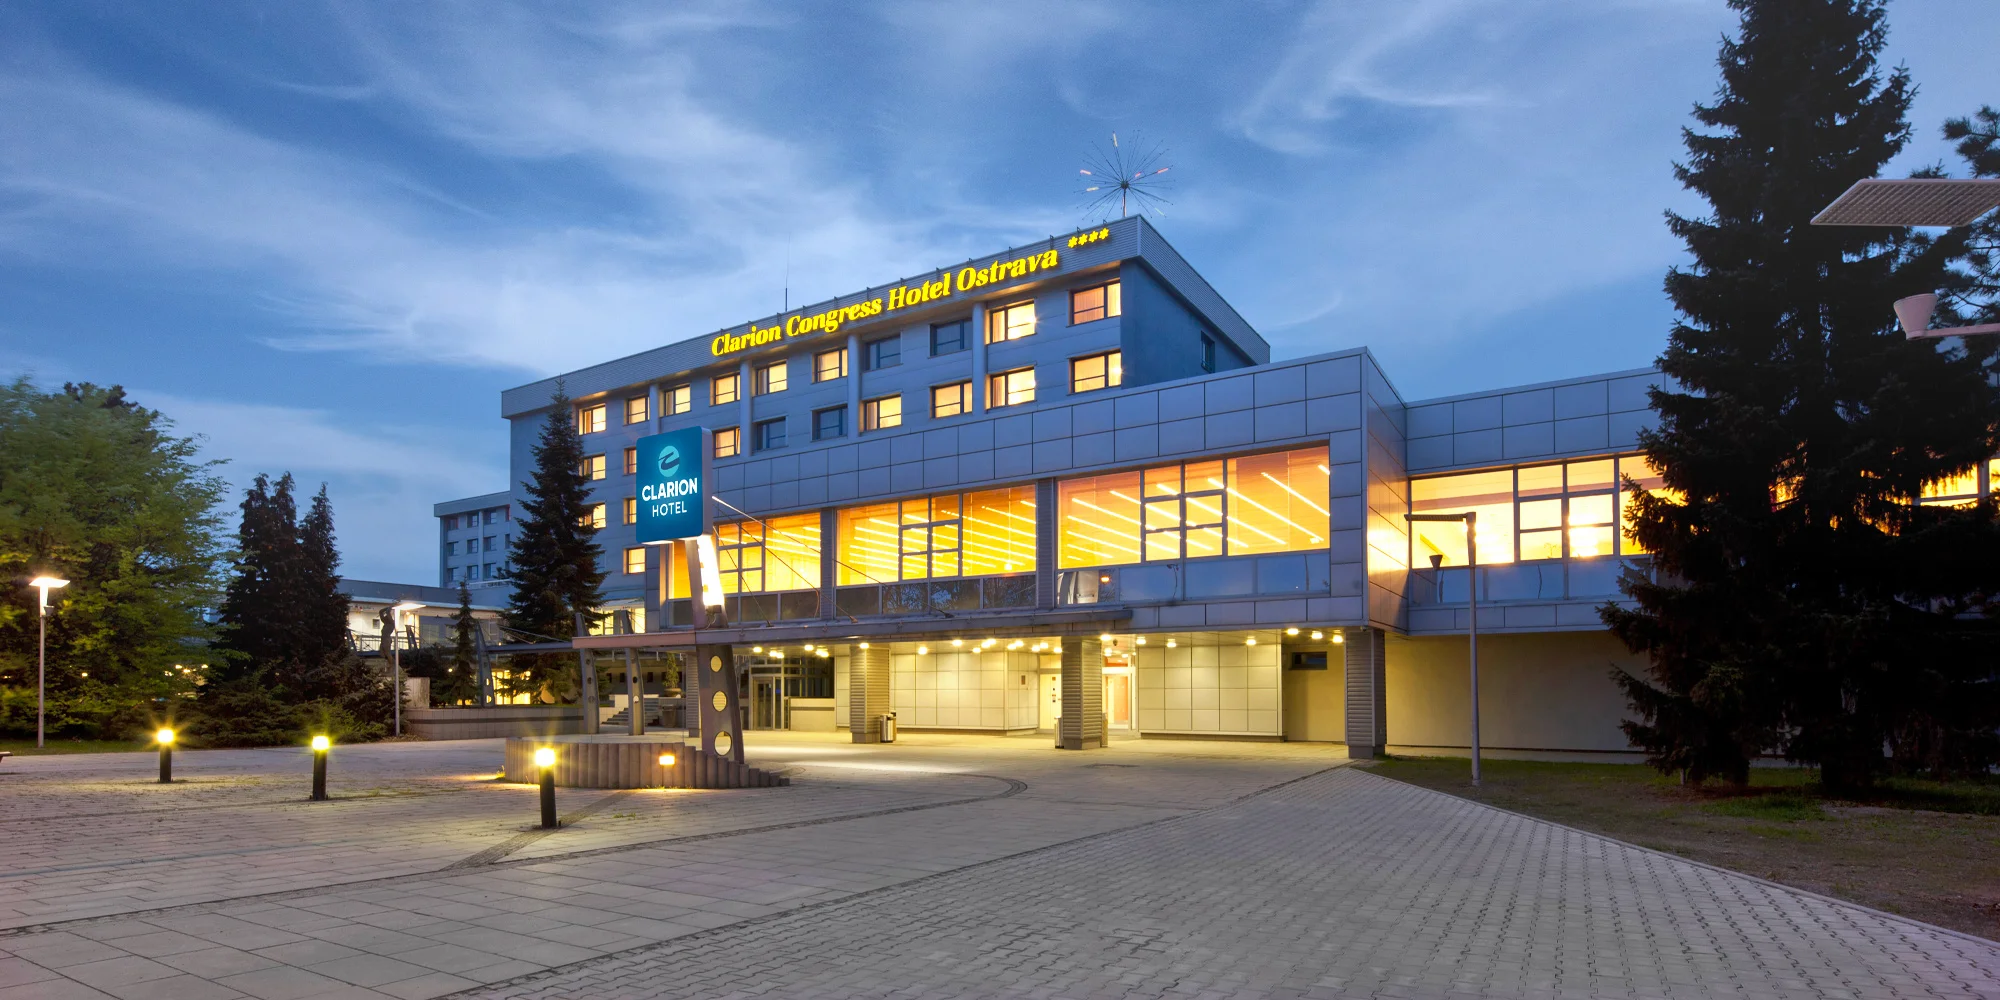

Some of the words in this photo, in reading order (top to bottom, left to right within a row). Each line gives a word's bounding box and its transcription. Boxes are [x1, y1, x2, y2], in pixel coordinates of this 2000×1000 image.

[711, 325, 782, 357] Clarion
[786, 298, 882, 333] Congress
[888, 272, 950, 311] Hotel
[957, 249, 1058, 290] Ostrava
[641, 477, 698, 502] CLARION
[652, 501, 687, 518] HOTEL
